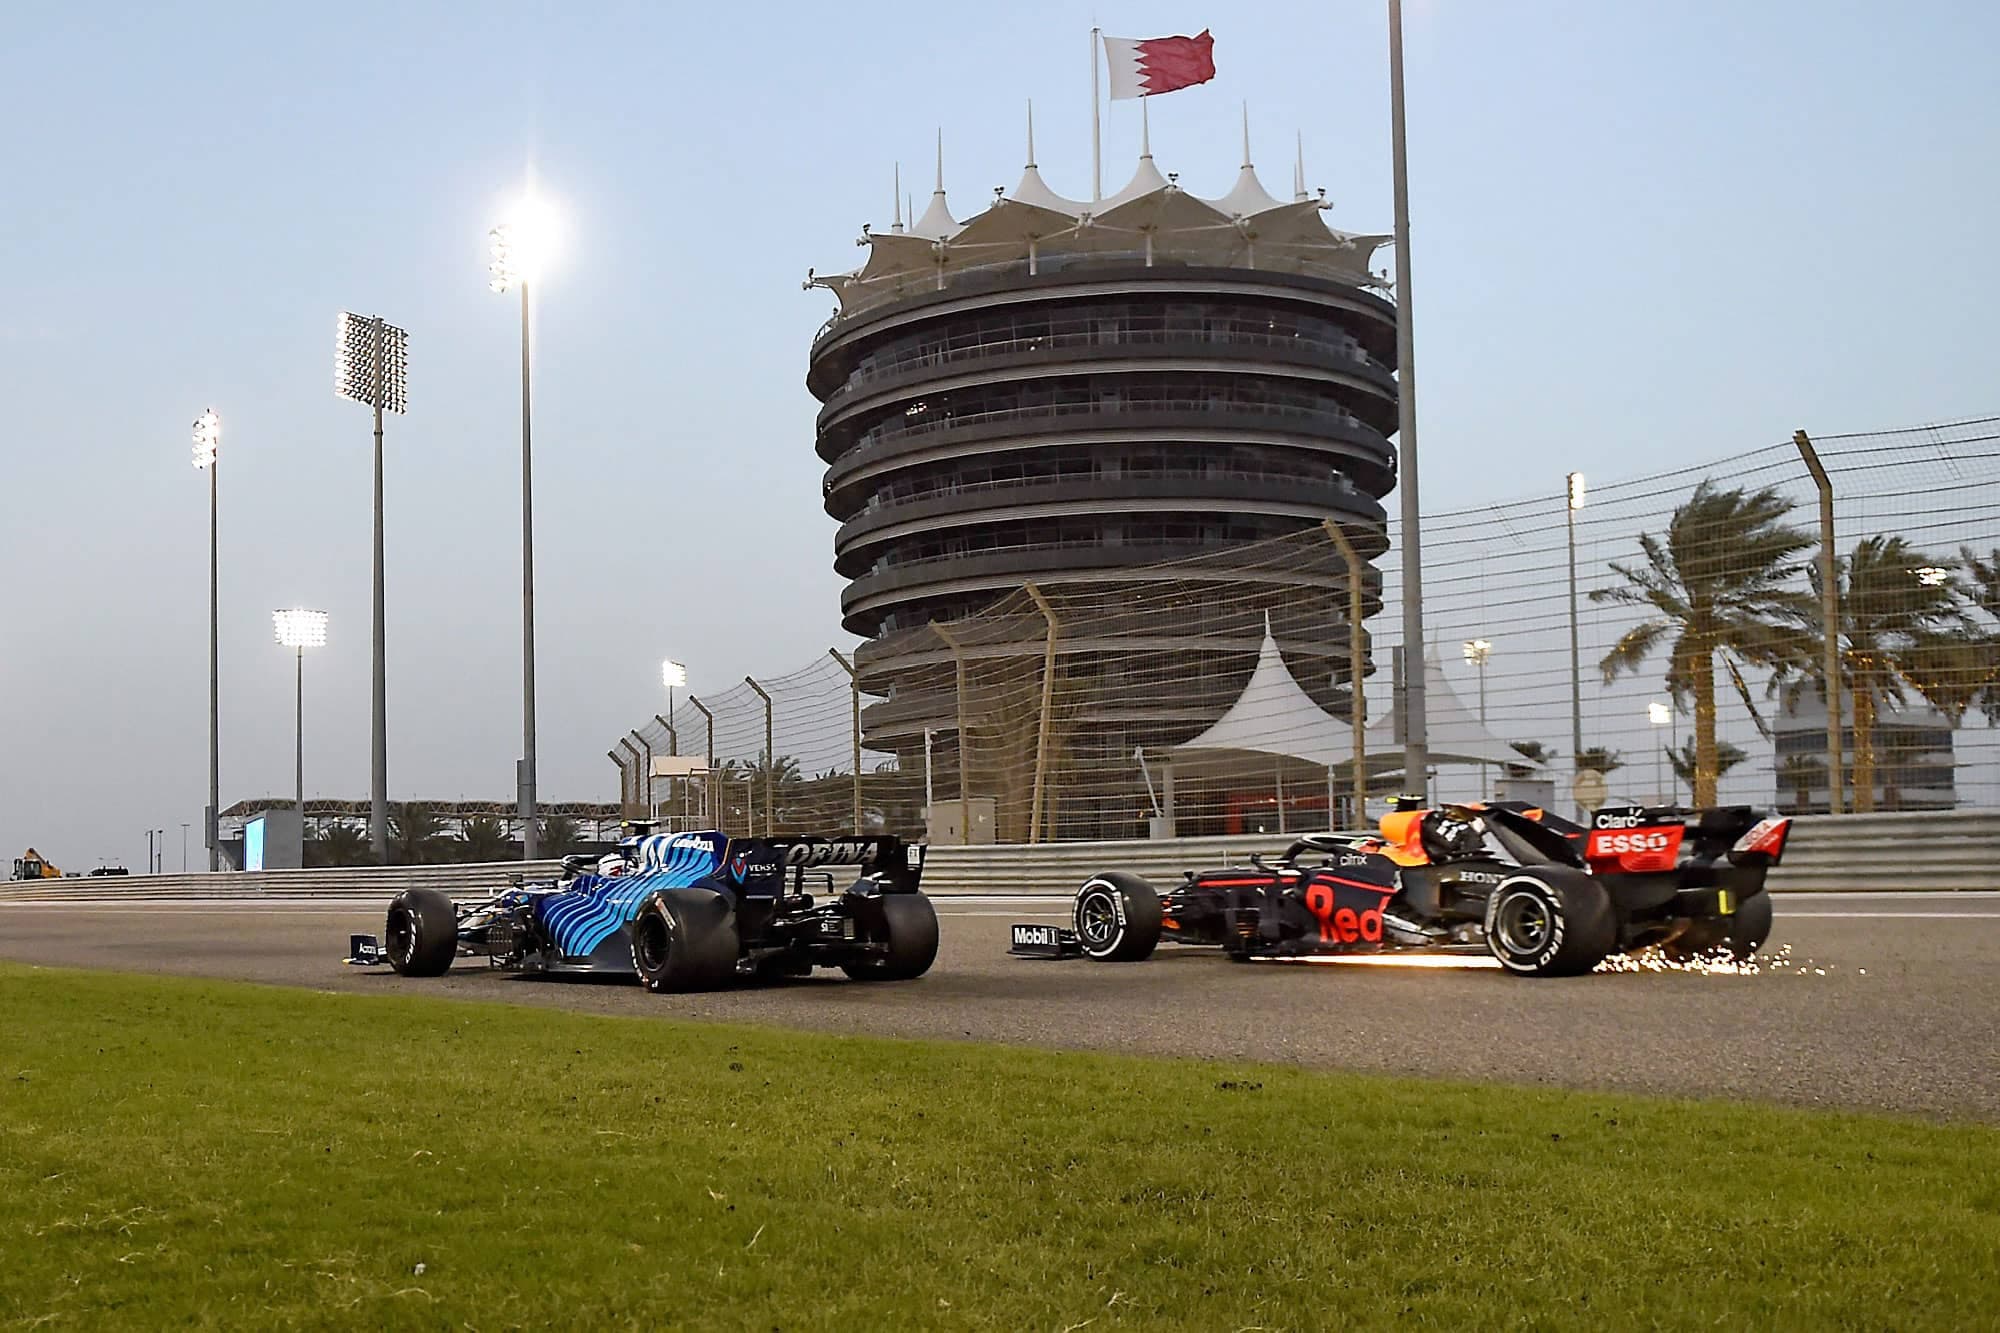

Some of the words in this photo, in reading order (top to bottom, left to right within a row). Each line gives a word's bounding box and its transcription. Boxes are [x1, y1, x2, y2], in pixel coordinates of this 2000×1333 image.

[1596, 814, 1638, 829] Claro
[783, 842, 878, 865] OFINA
[1460, 871, 1506, 884] HON
[1306, 883, 1391, 943] Red
[1014, 927, 1048, 944] Mobil
[1049, 929, 1057, 945] 1
